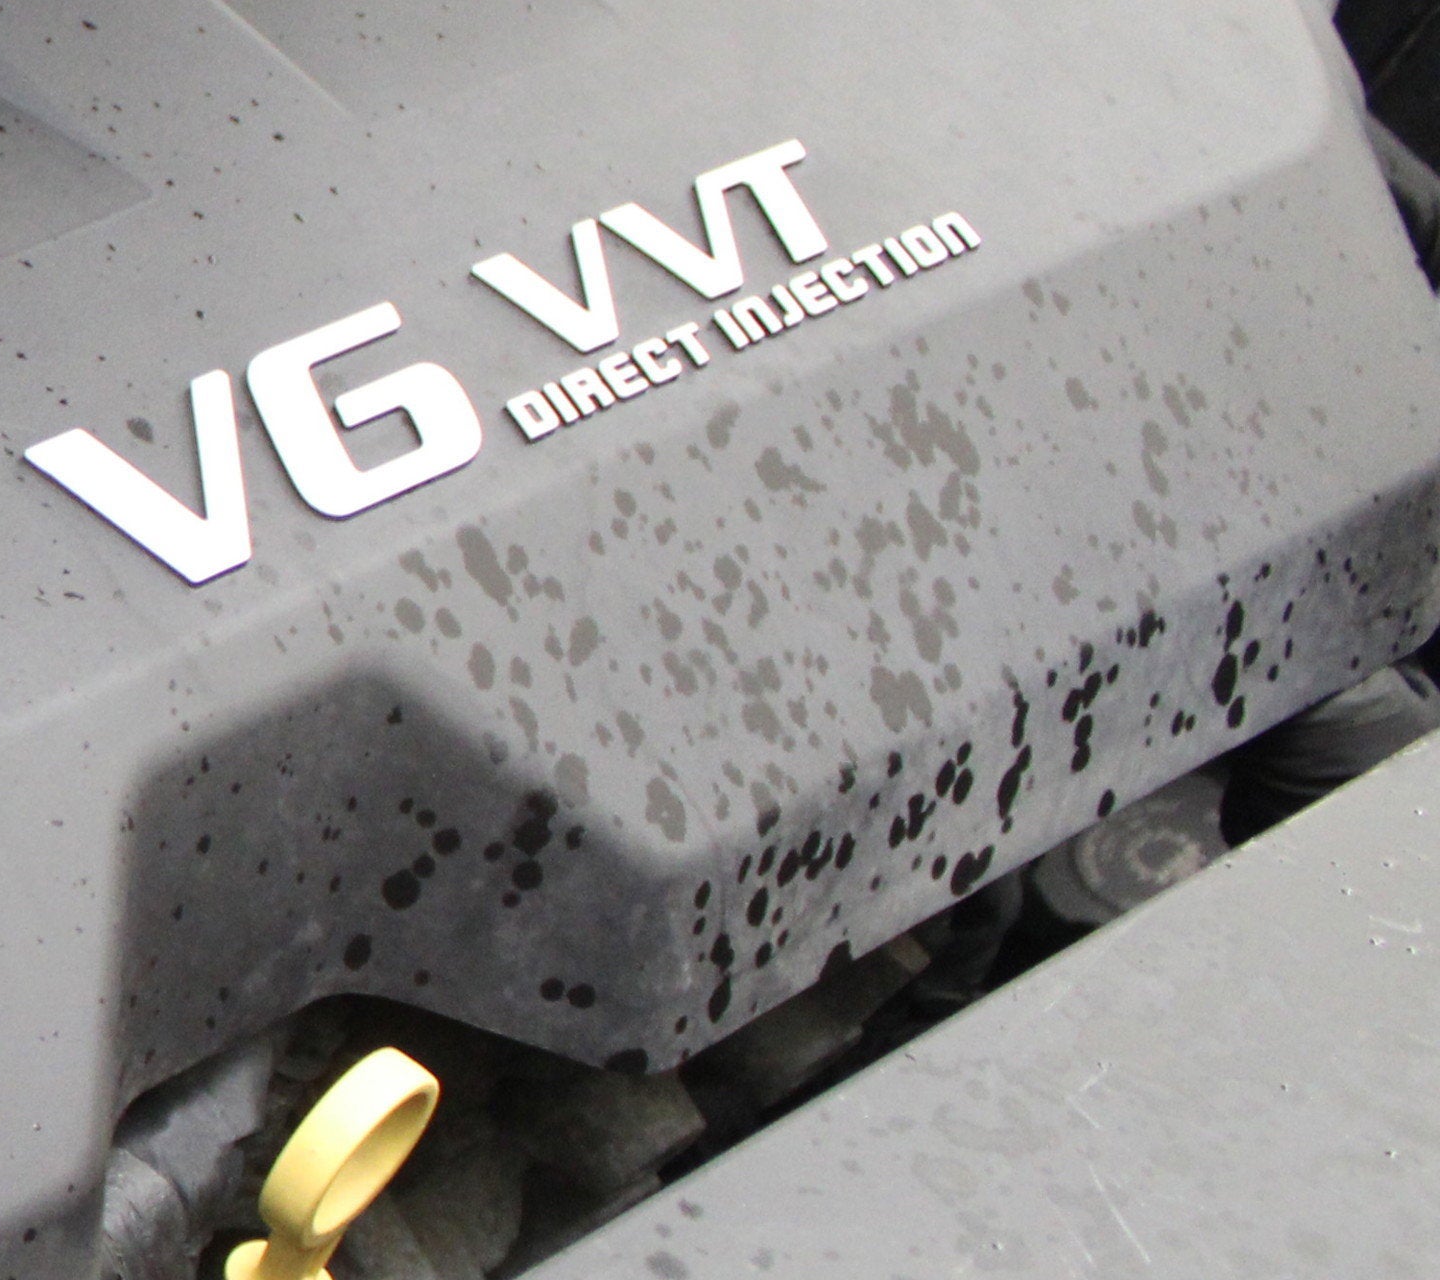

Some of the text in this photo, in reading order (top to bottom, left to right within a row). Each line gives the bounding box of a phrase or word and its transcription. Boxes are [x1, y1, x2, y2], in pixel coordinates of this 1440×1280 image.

[26, 140, 828, 584] V6 VVT
[506, 211, 981, 440] DIRECT INJECTION
